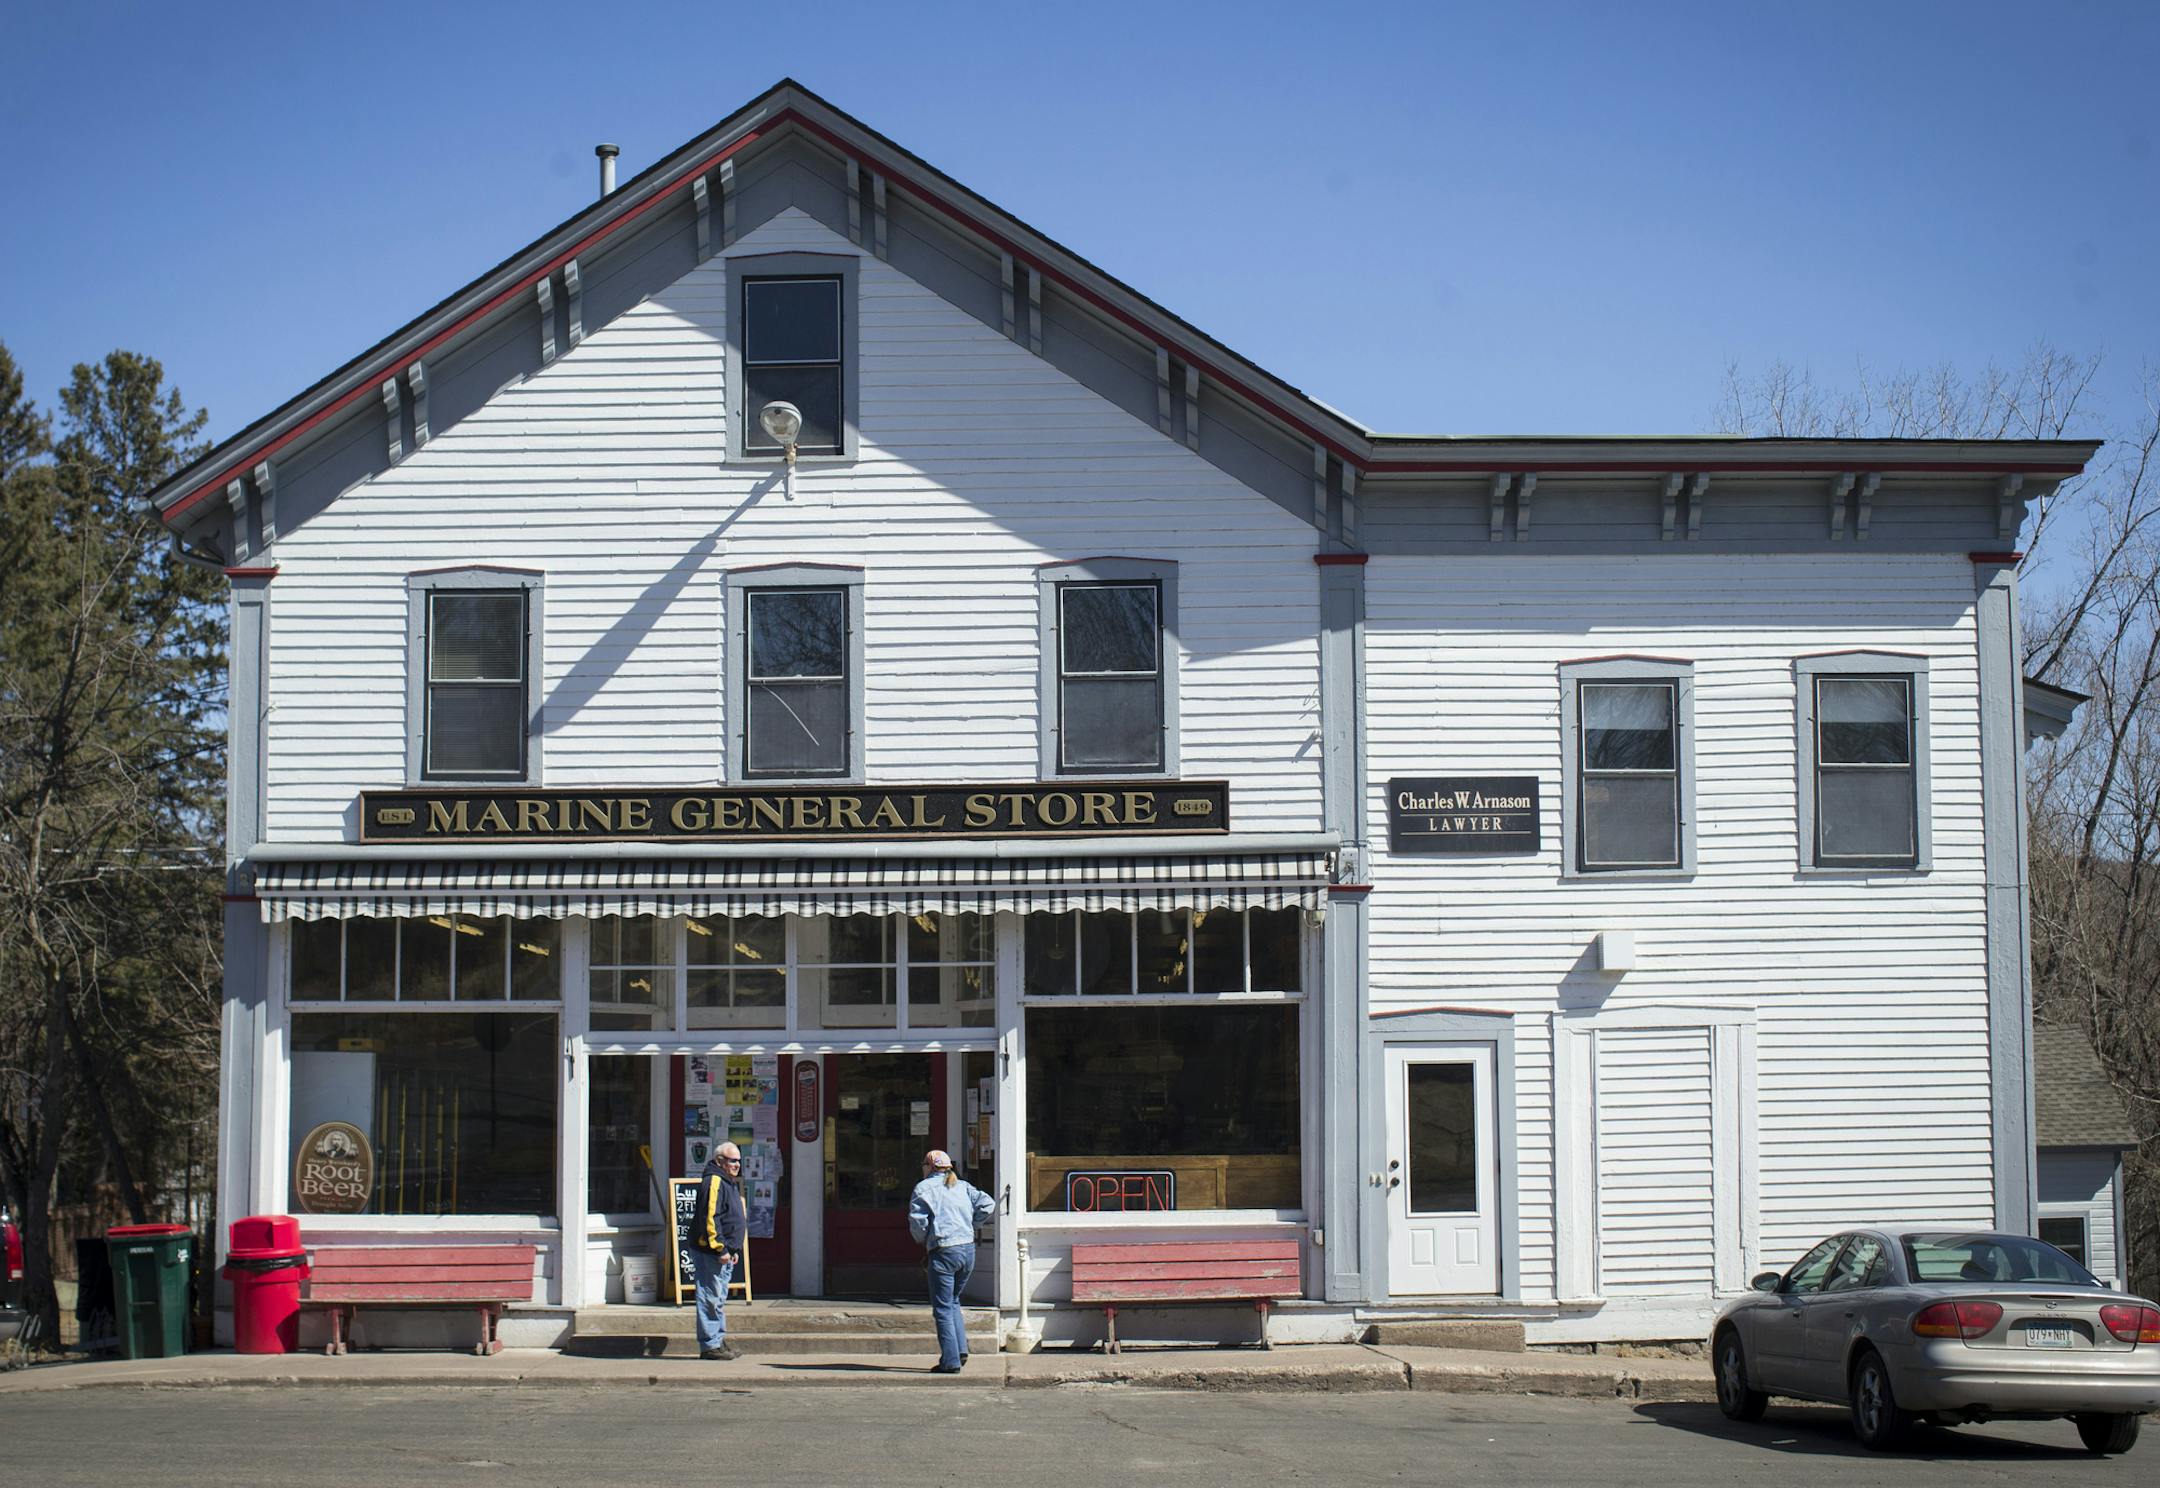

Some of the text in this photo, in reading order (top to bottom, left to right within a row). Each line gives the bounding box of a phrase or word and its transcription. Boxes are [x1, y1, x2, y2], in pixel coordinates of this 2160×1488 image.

[1177, 802, 1209, 812] 1849
[1398, 791, 1531, 810] Charles W. Arnason
[426, 791, 1159, 833] MARINE GENERAL STORE
[1429, 817, 1502, 831] LAWYER
[1071, 1176, 1169, 1213] OPEN
